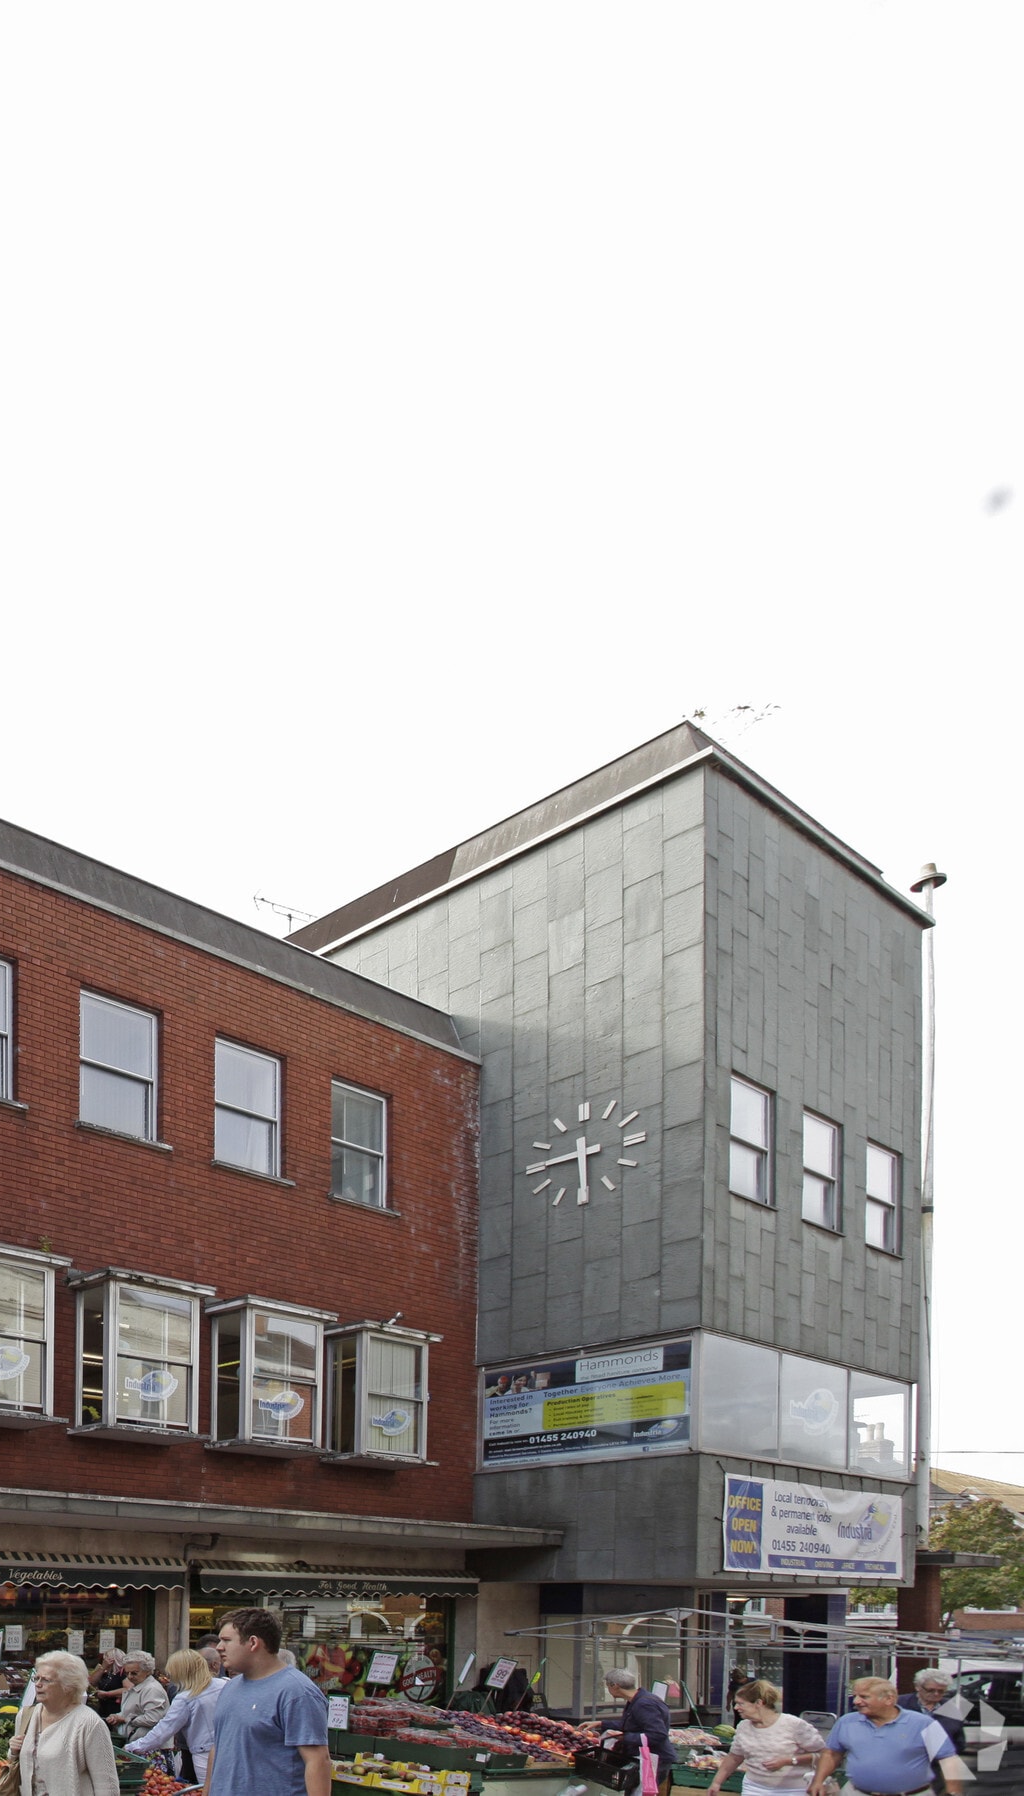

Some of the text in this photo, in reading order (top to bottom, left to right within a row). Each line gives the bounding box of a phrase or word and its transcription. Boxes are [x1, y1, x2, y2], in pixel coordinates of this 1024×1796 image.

[579, 1350, 659, 1371] Hammonds
[543, 1388, 578, 1398] Together
[580, 1383, 617, 1393] Everyone
[619, 1377, 656, 1387] Achieves
[489, 1395, 525, 1405] Interested
[547, 1393, 616, 1406] Production Operatives
[489, 1403, 517, 1412] working
[489, 1407, 533, 1418] Hammonds?
[529, 1429, 597, 1444] 01455 240940
[728, 1495, 762, 1511] OFFICE
[774, 1491, 792, 1503] Local
[770, 1505, 777, 1517] &
[817, 1511, 833, 1523] jobs
[731, 1517, 757, 1533] OPEN
[786, 1524, 818, 1536] available
[837, 1521, 873, 1540] Industria
[730, 1540, 757, 1554] NOW!
[772, 1539, 831, 1554] 01455 240940
[8, 1568, 64, 1584] Vegetables
[318, 1580, 387, 1591] For Good Health
